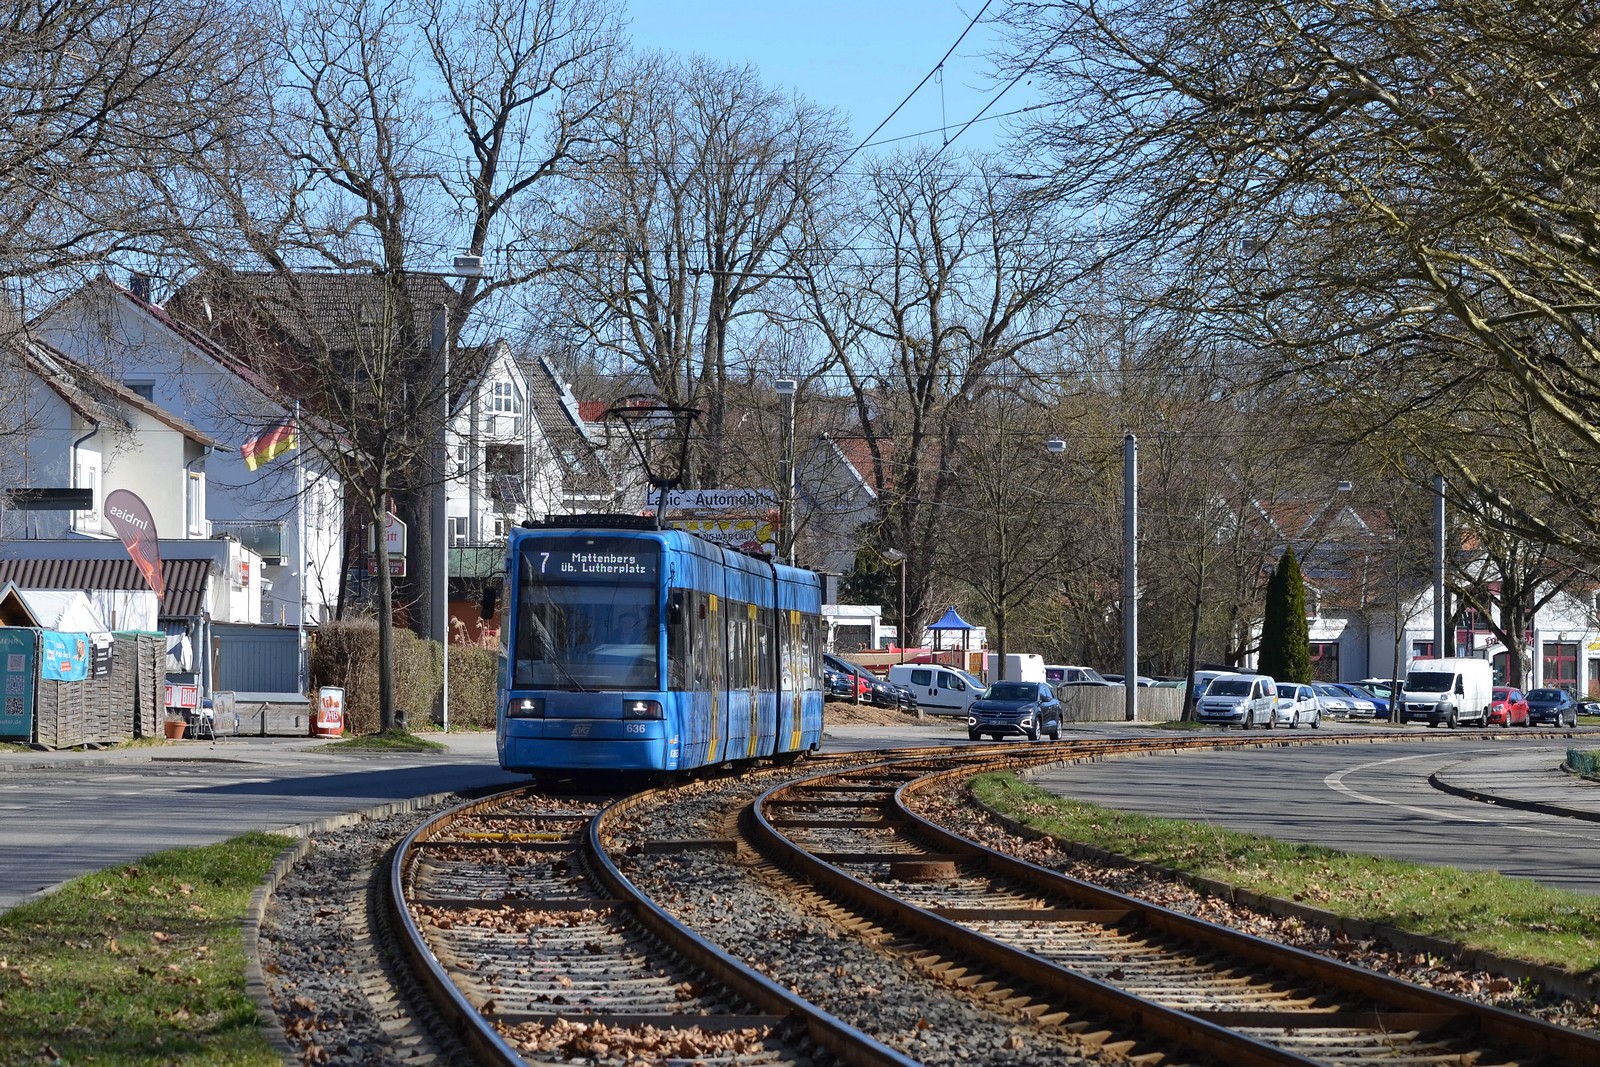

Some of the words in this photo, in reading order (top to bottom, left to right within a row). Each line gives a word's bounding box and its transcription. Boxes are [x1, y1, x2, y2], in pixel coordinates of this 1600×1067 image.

[540, 552, 549, 573] 7
[571, 552, 636, 564] Mattenberg
[561, 562, 577, 572] üb.
[582, 563, 646, 574] Lutherplatz
[183, 689, 196, 705] Bild
[626, 724, 646, 733] 636
